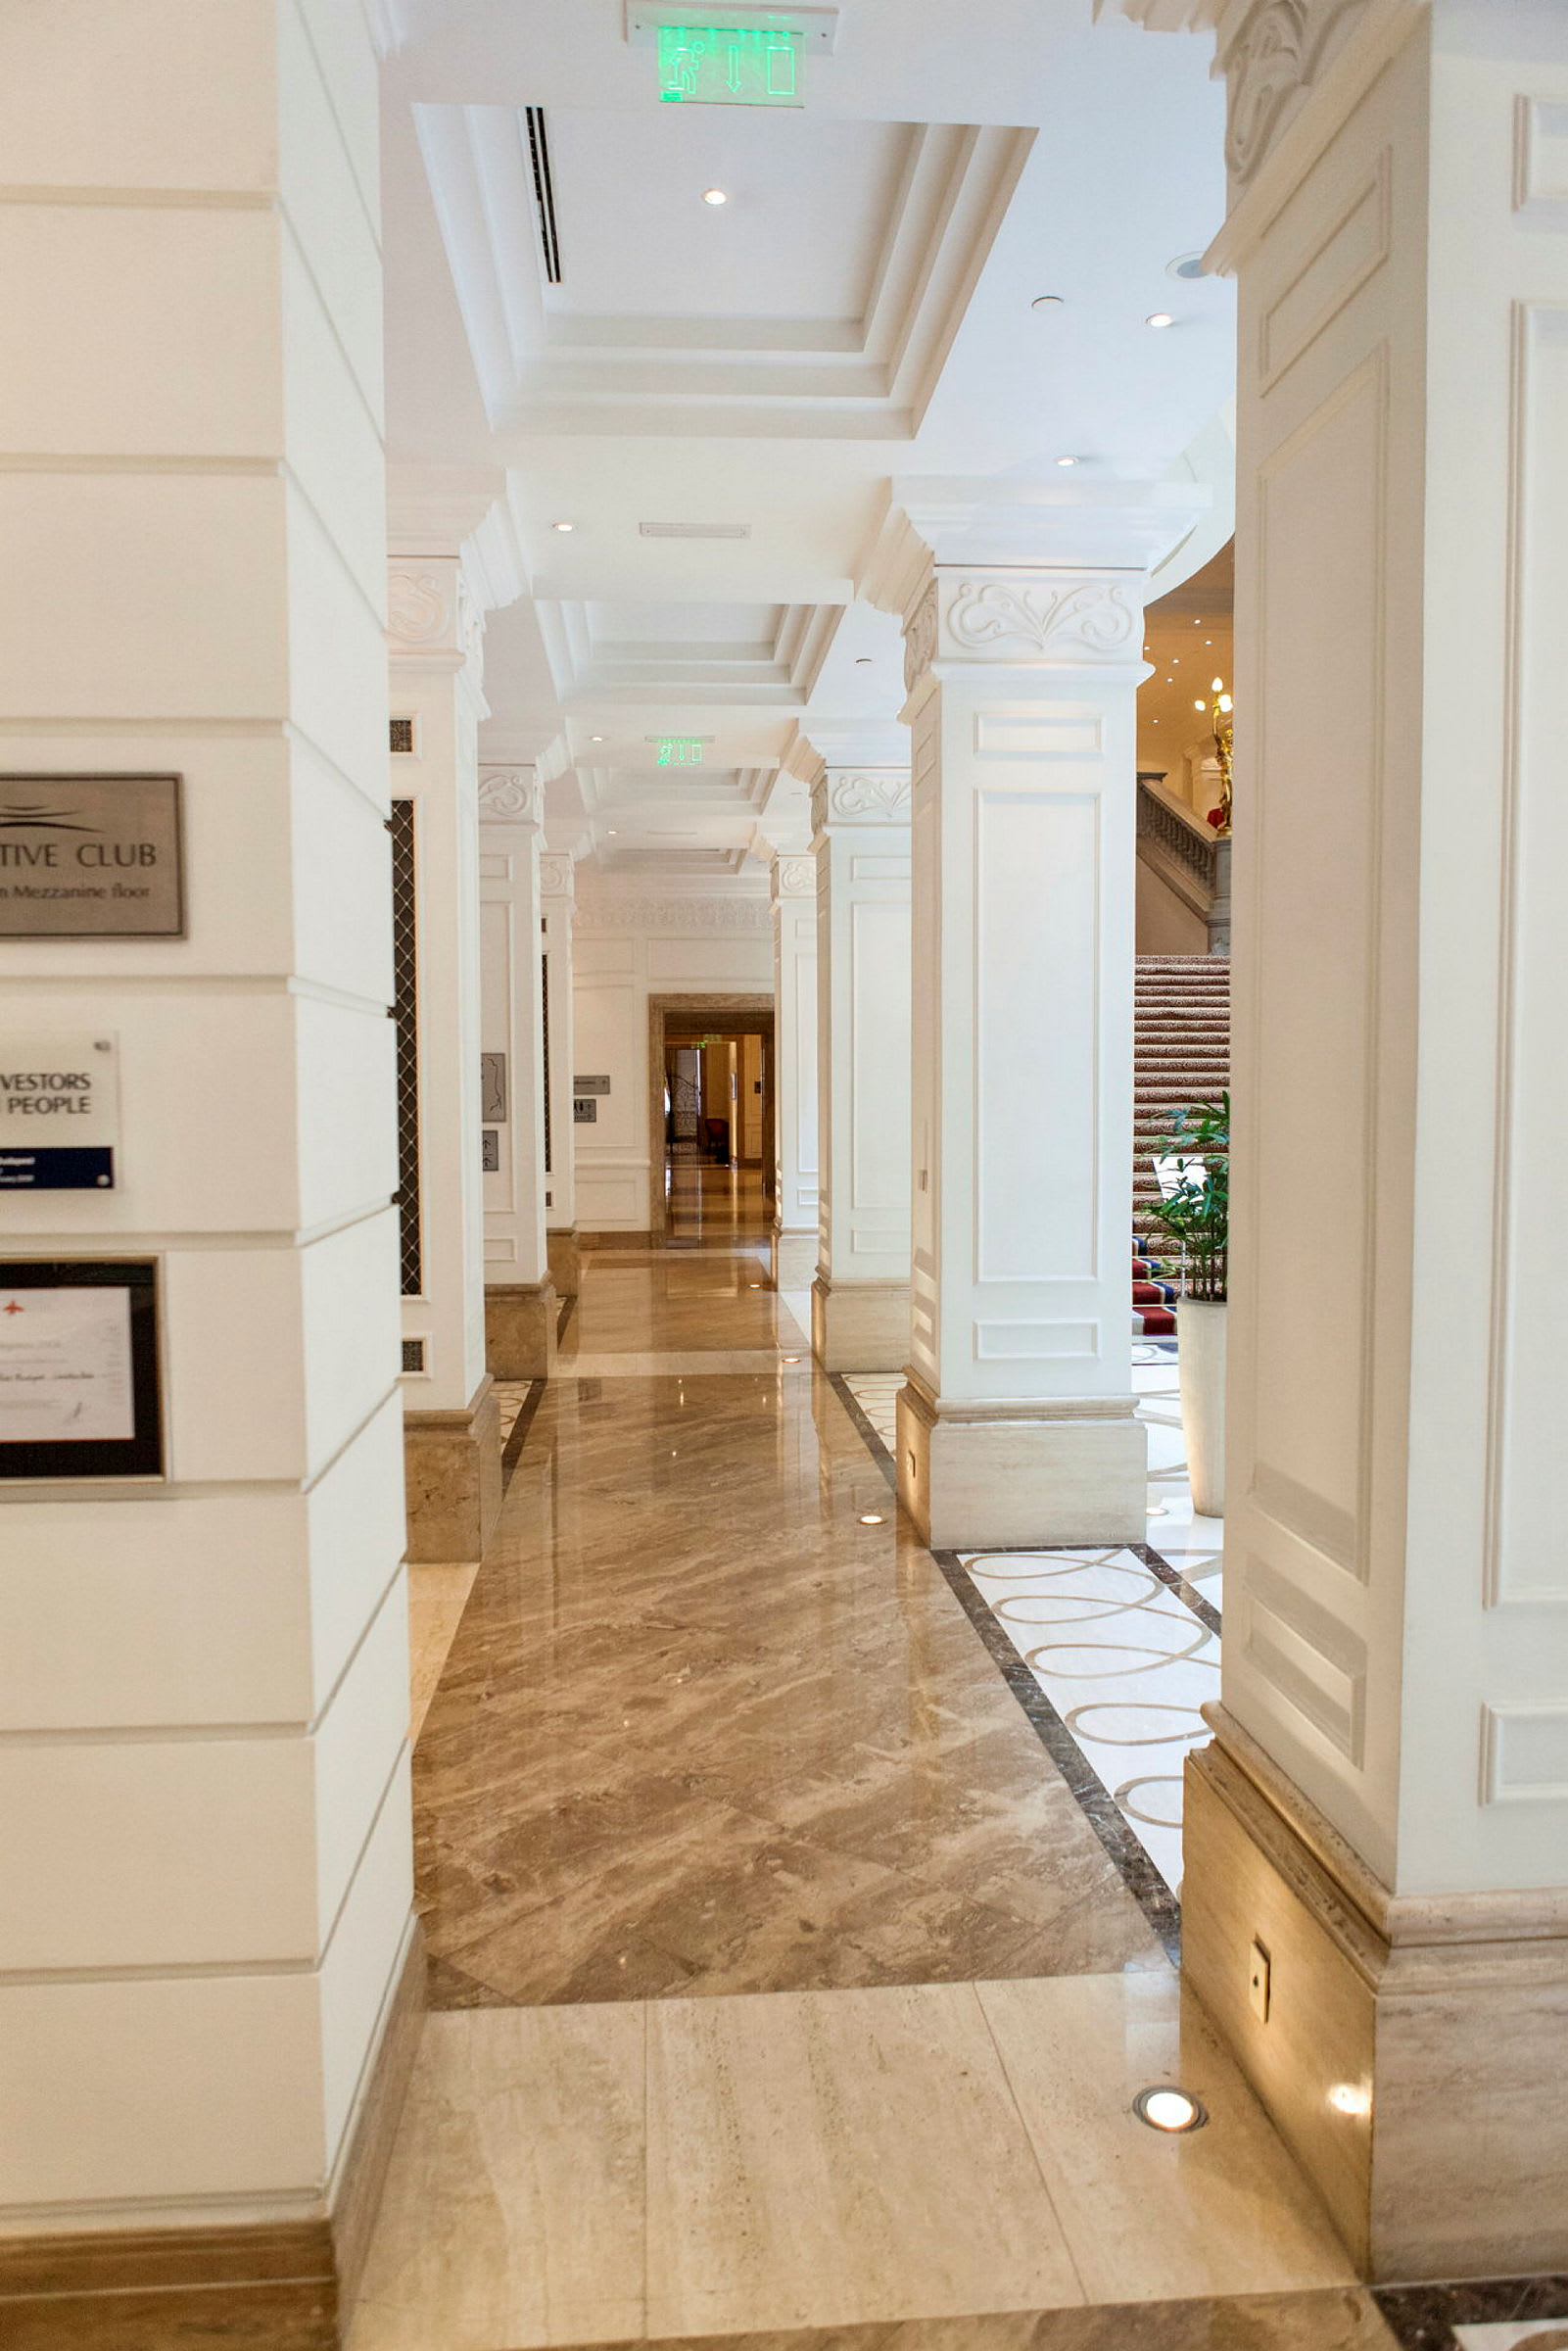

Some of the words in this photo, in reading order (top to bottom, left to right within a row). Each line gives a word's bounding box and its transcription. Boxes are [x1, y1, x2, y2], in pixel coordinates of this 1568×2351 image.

[0, 843, 58, 867] TIVE
[76, 843, 157, 868] CLUB
[15, 885, 106, 899] Mezzanine
[111, 883, 150, 898] floor
[0, 1073, 91, 1091] VESTORS
[8, 1096, 91, 1115] PEOPLE
